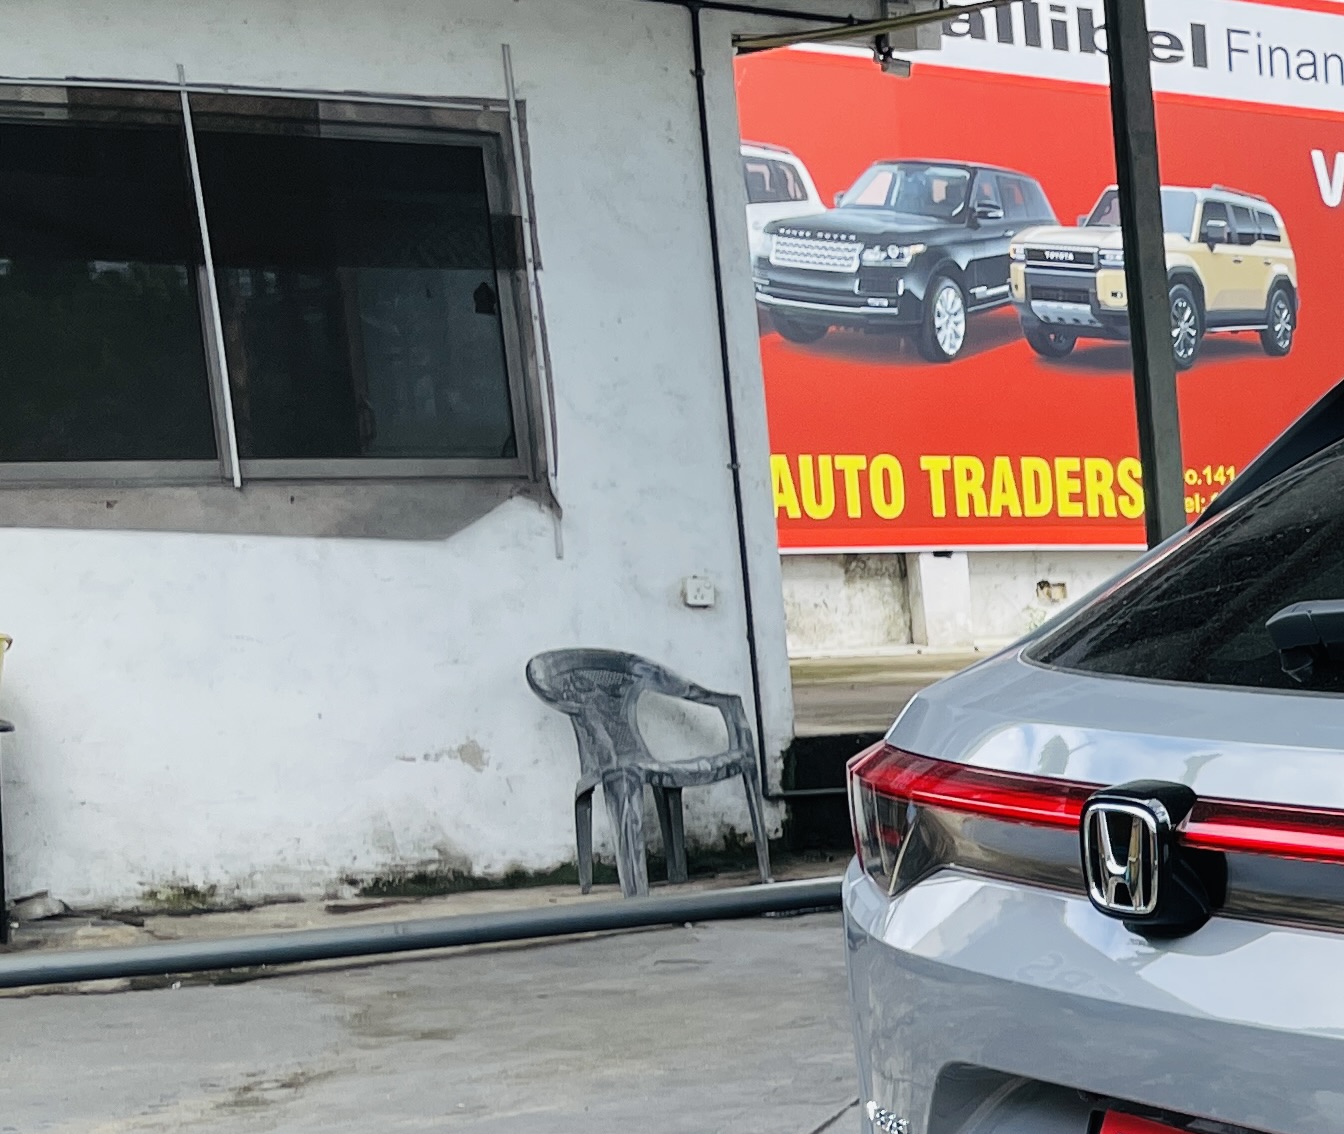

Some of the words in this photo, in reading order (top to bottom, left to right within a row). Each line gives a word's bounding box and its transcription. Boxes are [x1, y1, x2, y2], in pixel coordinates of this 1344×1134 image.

[942, 0, 1208, 69] allibel
[769, 454, 906, 519] AUTO
[920, 456, 1145, 519] TRADERS
[1184, 464, 1236, 486] o.141
